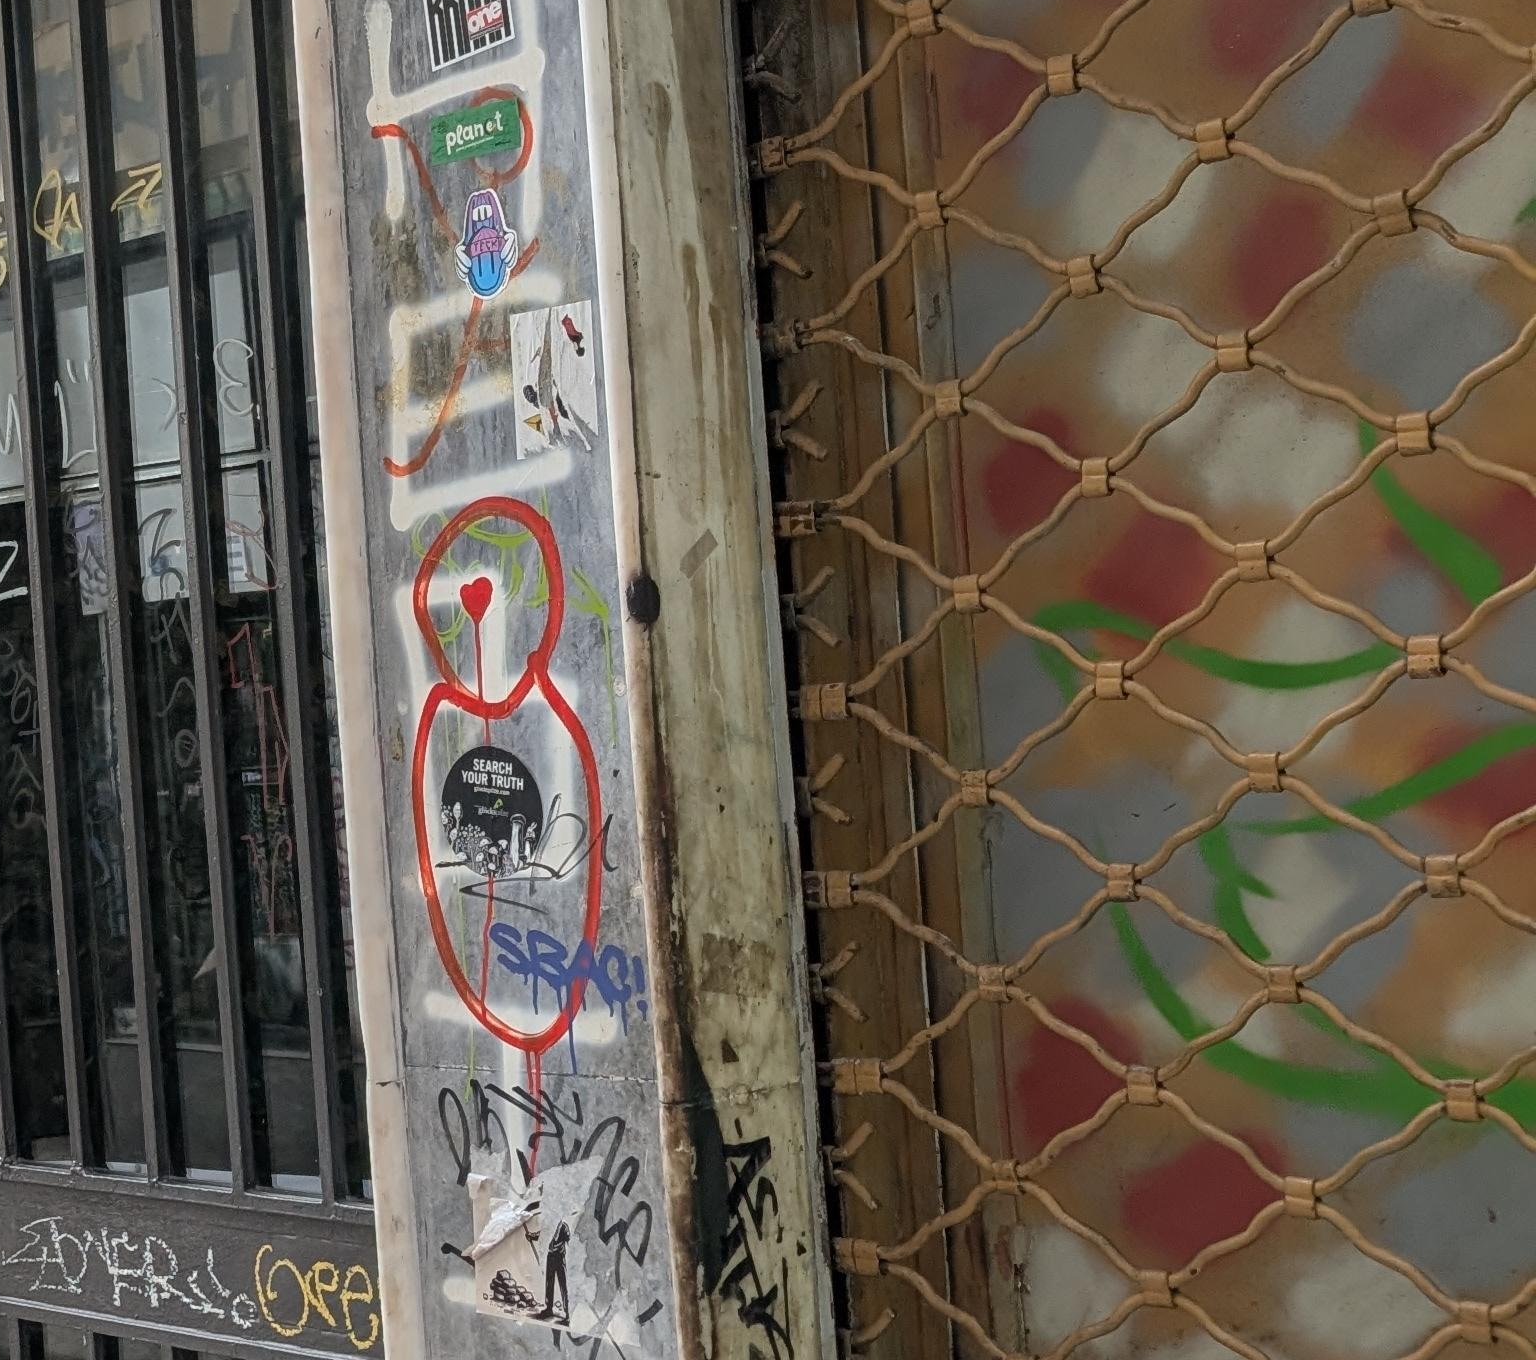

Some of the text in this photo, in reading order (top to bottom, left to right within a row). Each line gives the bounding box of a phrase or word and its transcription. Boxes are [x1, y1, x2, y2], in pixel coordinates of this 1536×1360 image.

[467, 0, 503, 35] one
[445, 111, 504, 155] planet
[461, 770, 524, 791] YOUR TRUTH
[473, 758, 513, 775] SEARCH
